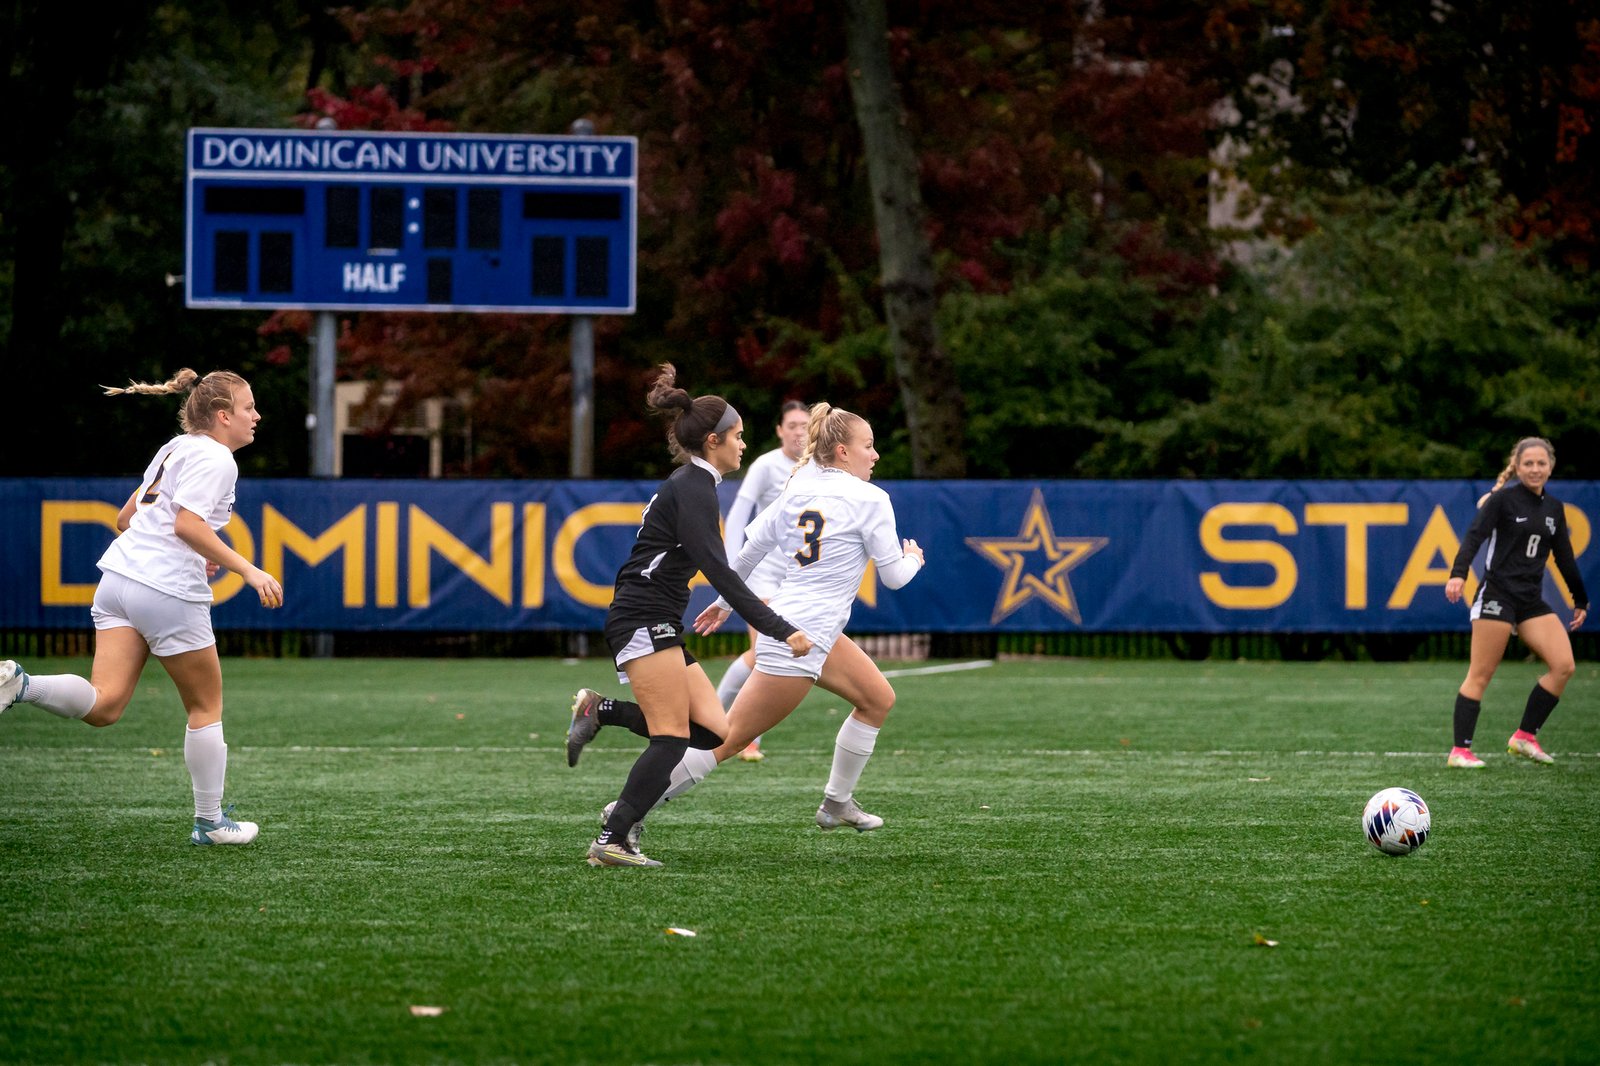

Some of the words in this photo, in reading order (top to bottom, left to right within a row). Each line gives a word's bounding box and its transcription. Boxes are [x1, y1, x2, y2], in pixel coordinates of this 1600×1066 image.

[202, 138, 407, 169] DOMINICAN
[417, 142, 624, 173] UNIVERSITY
[343, 262, 407, 293] HALF
[40, 499, 878, 609] DMINIC
[796, 508, 826, 567] 3
[1526, 534, 1541, 558] 8
